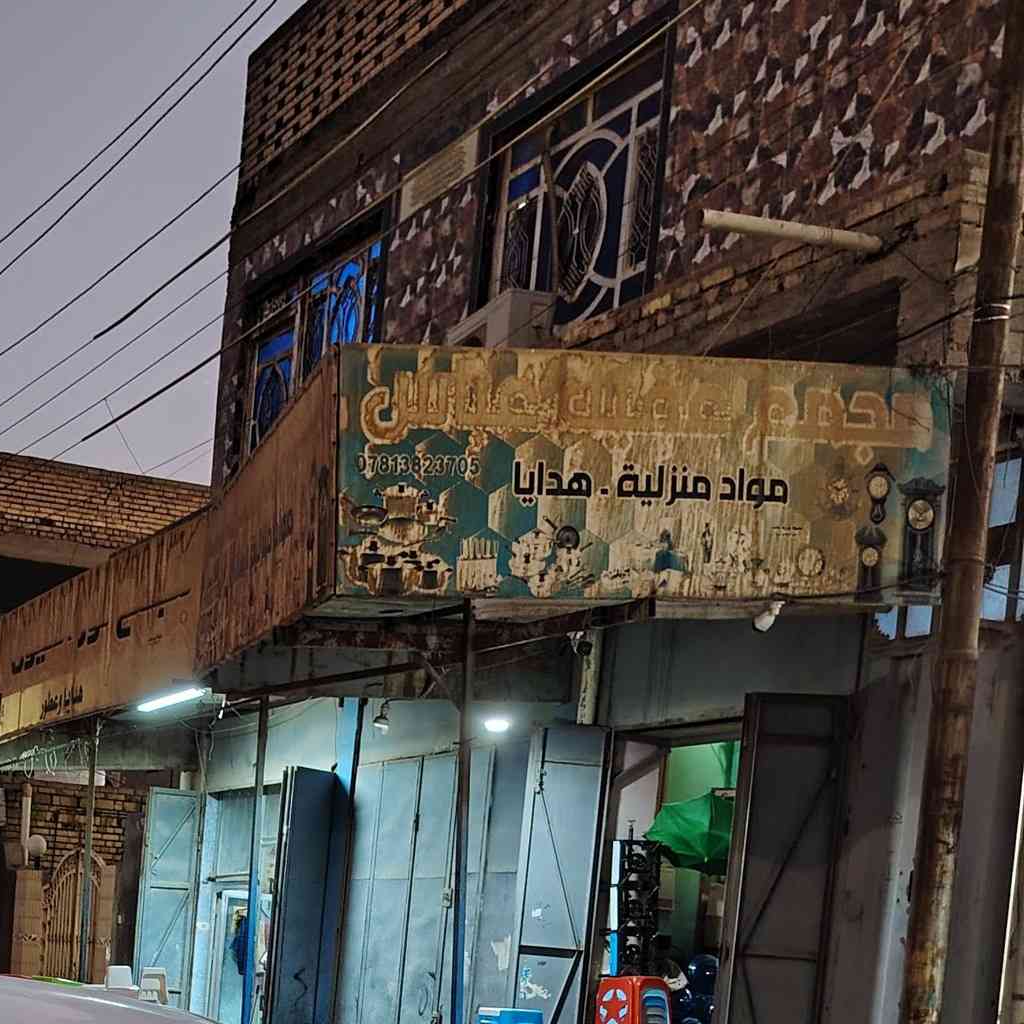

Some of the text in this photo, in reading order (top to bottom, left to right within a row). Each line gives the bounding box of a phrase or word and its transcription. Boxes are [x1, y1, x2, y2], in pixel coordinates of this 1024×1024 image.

[355, 454, 480, 476] 07813823705
[514, 462, 592, 504] هدايا
[617, 463, 712, 506] منزلية
[720, 468, 789, 509] مواد
